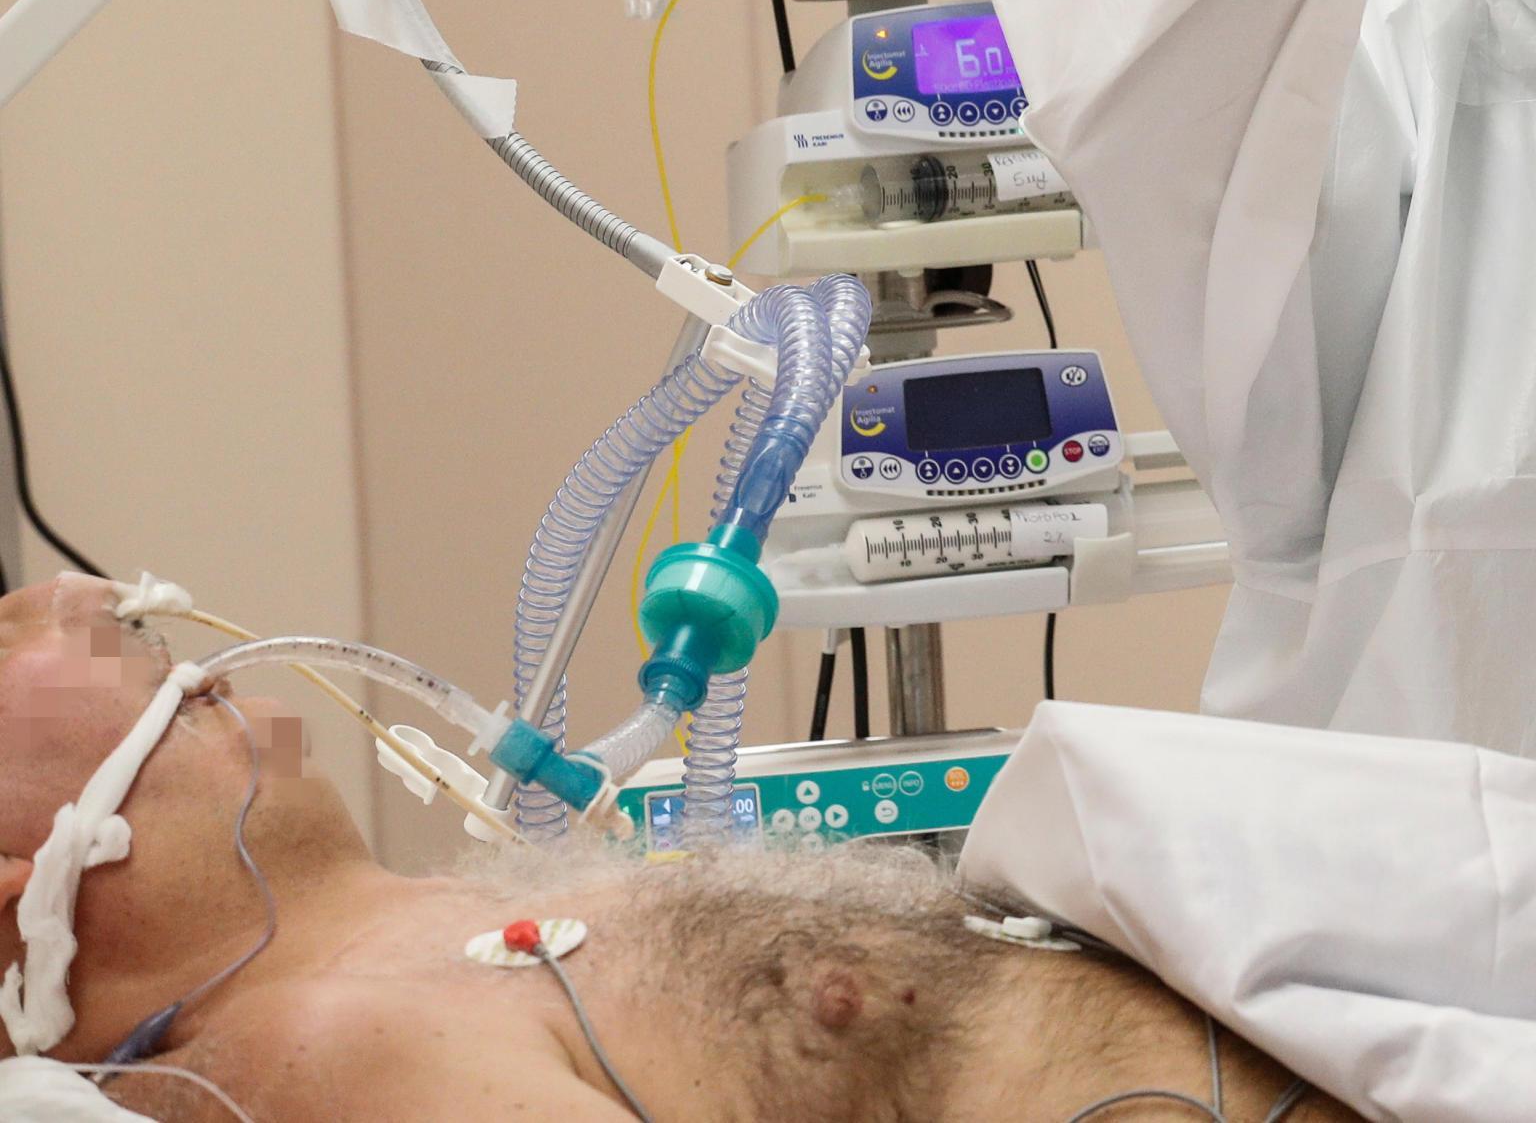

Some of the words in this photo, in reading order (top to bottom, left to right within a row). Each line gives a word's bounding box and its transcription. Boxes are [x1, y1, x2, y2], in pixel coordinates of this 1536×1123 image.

[869, 58, 893, 69] Agilia
[946, 164, 959, 180] 20
[981, 161, 994, 177] 30
[857, 415, 882, 426] Agilia
[1064, 447, 1082, 457] STOP
[893, 519, 905, 532] 10
[929, 515, 942, 528] 20
[966, 511, 979, 525] 30
[900, 559, 912, 567] 10
[936, 556, 948, 564] 20
[804, 815, 815, 823] OK
